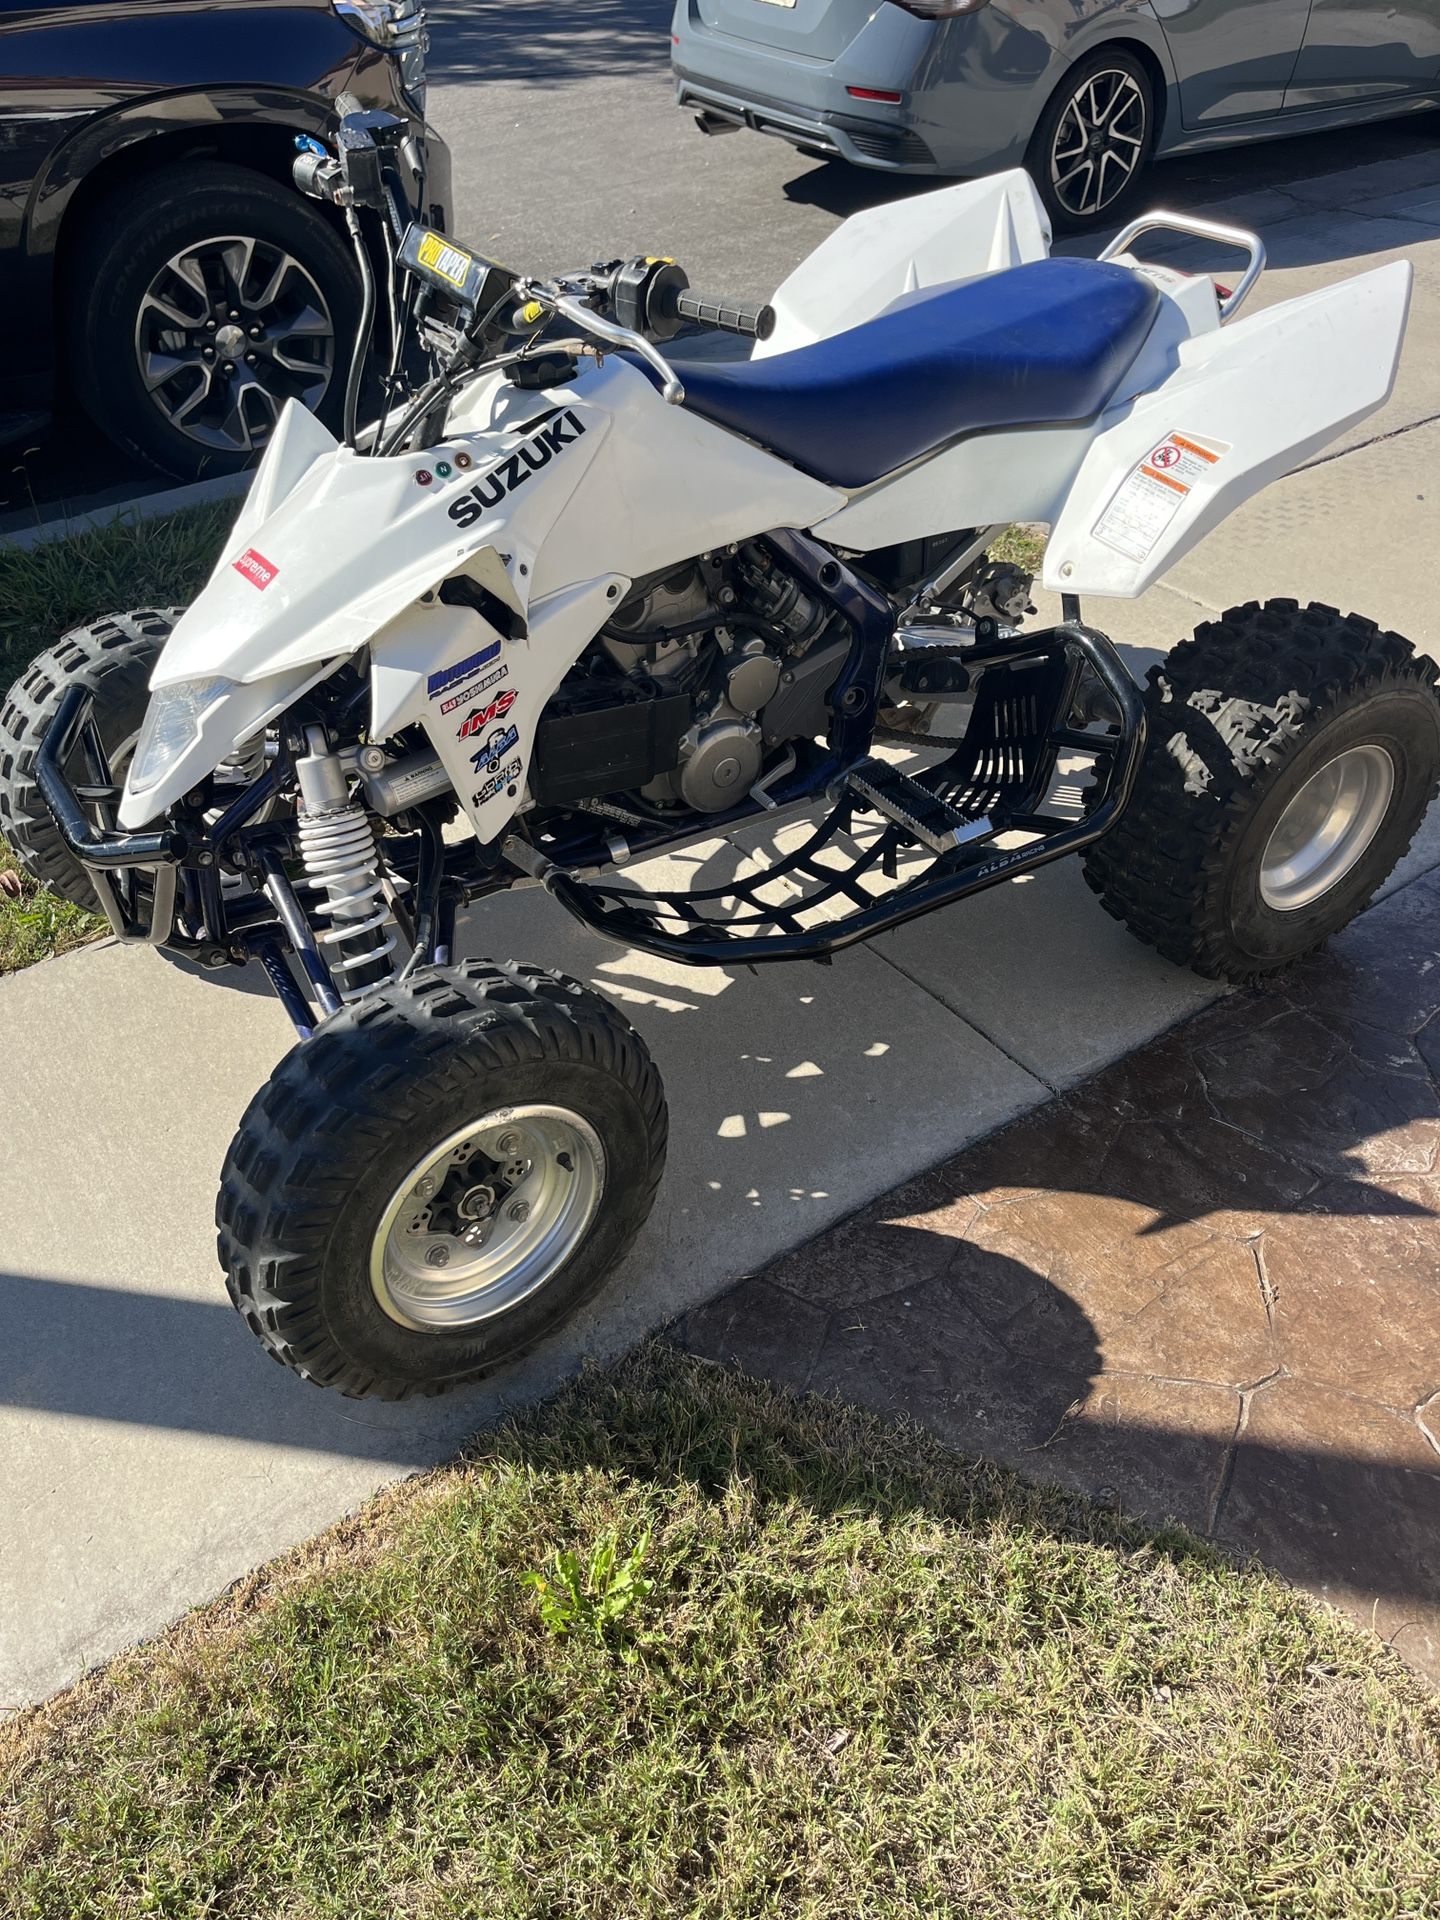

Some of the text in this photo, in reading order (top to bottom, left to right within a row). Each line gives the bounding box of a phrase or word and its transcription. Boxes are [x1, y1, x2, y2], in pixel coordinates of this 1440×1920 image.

[448, 410, 587, 529] SUZUKI
[457, 665, 509, 707] YOSHIMURA
[459, 688, 517, 742] IMS
